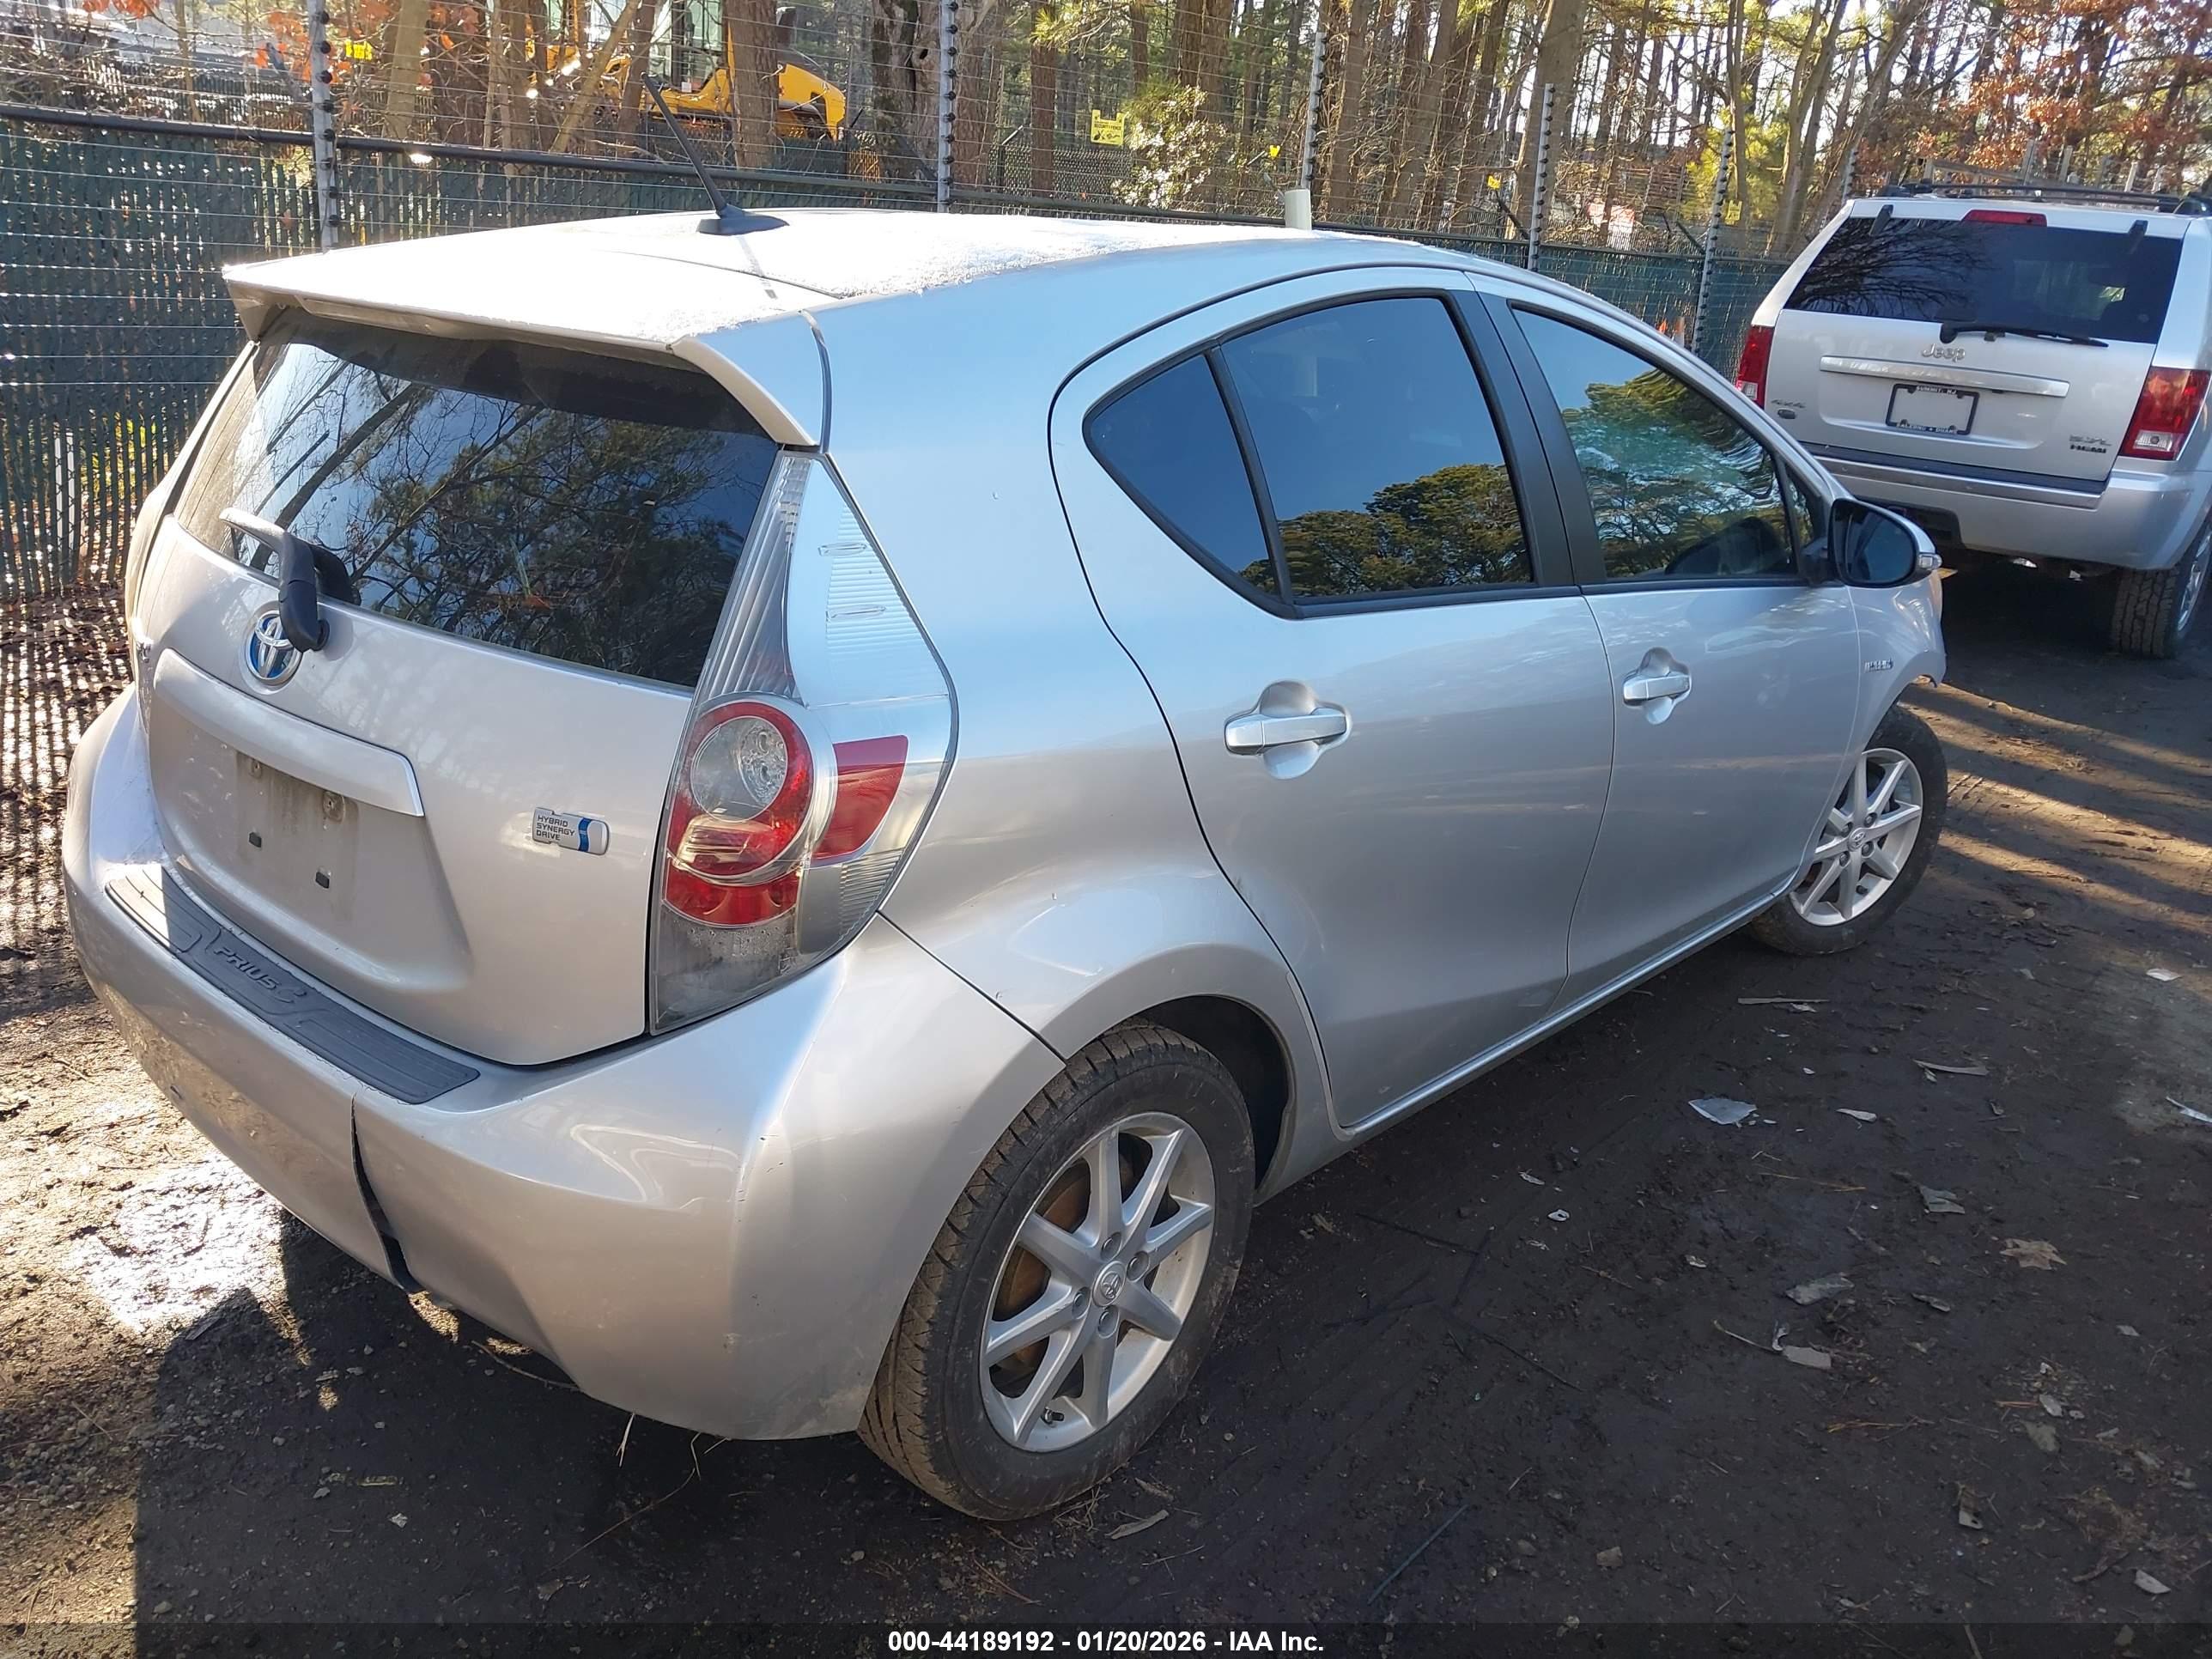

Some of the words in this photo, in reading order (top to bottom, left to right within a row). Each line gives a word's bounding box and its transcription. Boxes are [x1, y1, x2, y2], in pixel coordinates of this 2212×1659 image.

[1922, 343, 1966, 362] Jeep
[538, 814, 568, 828] HYBRID
[536, 822, 575, 836] SYNERGY
[536, 830, 561, 841] DRIVE
[214, 946, 281, 990] PRIUS
